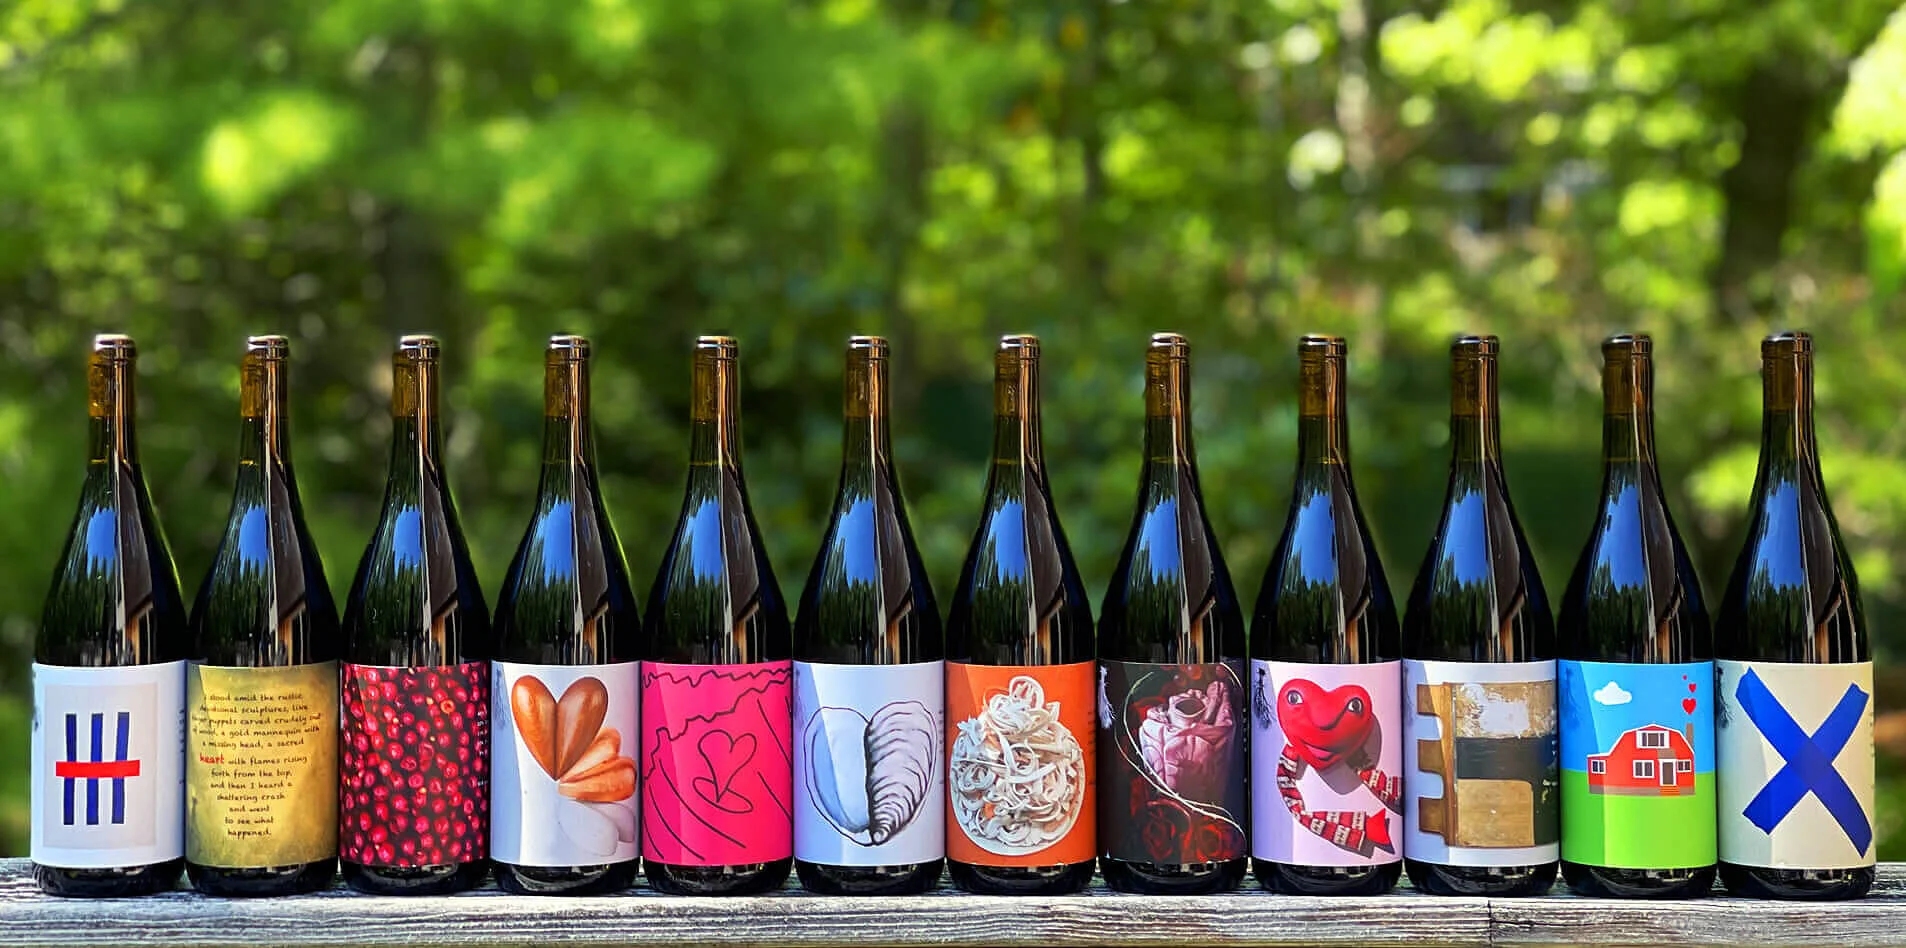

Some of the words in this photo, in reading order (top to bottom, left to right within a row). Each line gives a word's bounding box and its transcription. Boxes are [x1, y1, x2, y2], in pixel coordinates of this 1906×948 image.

[234, 692, 257, 701] amid
[260, 693, 274, 701] the
[278, 692, 303, 701] rustic
[292, 703, 309, 711] like
[208, 717, 237, 728] puppets
[240, 717, 270, 725] carved
[274, 715, 307, 725] crudely
[229, 729, 249, 739] gold
[253, 728, 301, 738] mannequin
[304, 725, 320, 733] with
[208, 741, 237, 750] missing
[240, 740, 264, 749] head,
[277, 738, 305, 747] sacred
[199, 752, 225, 764] heart
[228, 757, 246, 765] with
[250, 755, 280, 766] flames
[284, 756, 308, 765] rising
[211, 769, 230, 778] forth
[234, 769, 256, 779] from
[259, 769, 274, 777] the
[228, 781, 246, 789] then
[258, 781, 284, 789] heard
[217, 793, 258, 802] shattering
[261, 792, 285, 801] crash
[225, 816, 234, 824] to
[254, 816, 274, 824] what
[227, 828, 272, 840] happened.
